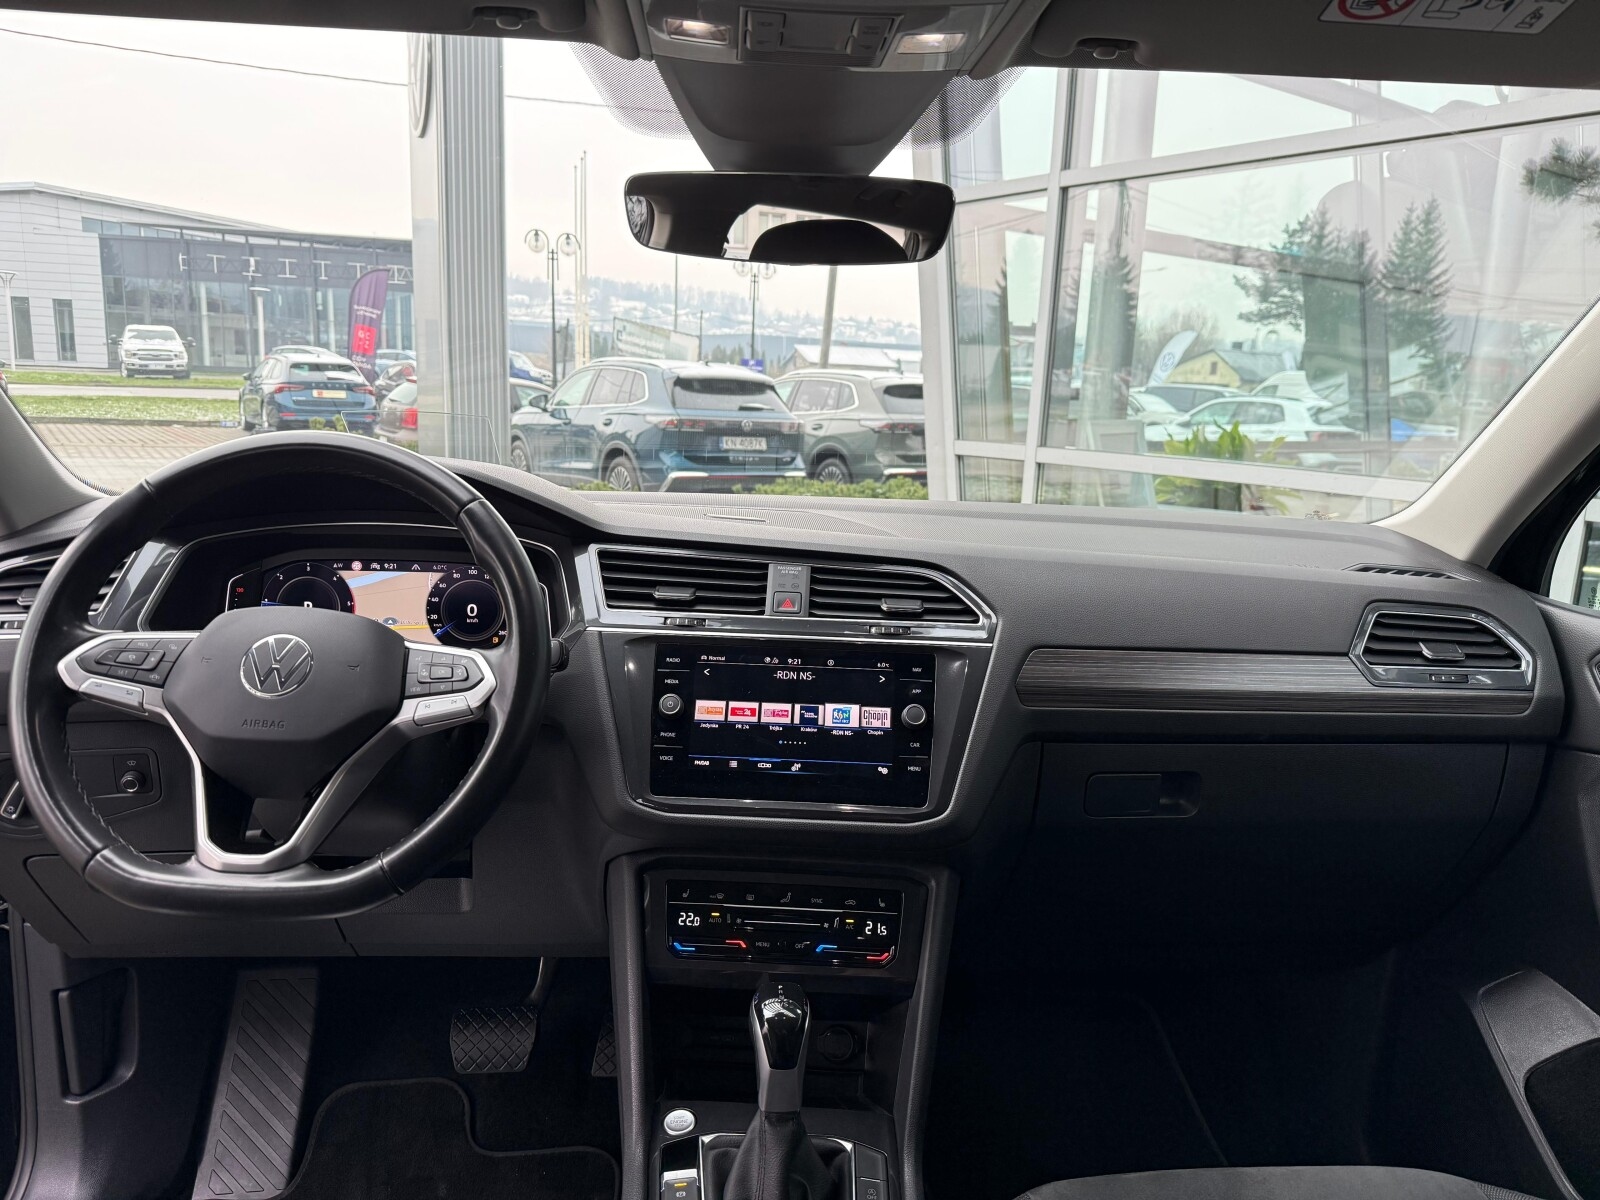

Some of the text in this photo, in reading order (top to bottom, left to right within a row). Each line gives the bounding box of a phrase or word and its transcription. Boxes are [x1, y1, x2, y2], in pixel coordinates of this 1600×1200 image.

[725, 438, 737, 448] KN
[467, 603, 478, 617] 0
[773, 670, 816, 681] -RDN NS-
[863, 709, 888, 726] Chopin
[240, 719, 287, 729] AIRBAG
[678, 912, 700, 926] 22.0
